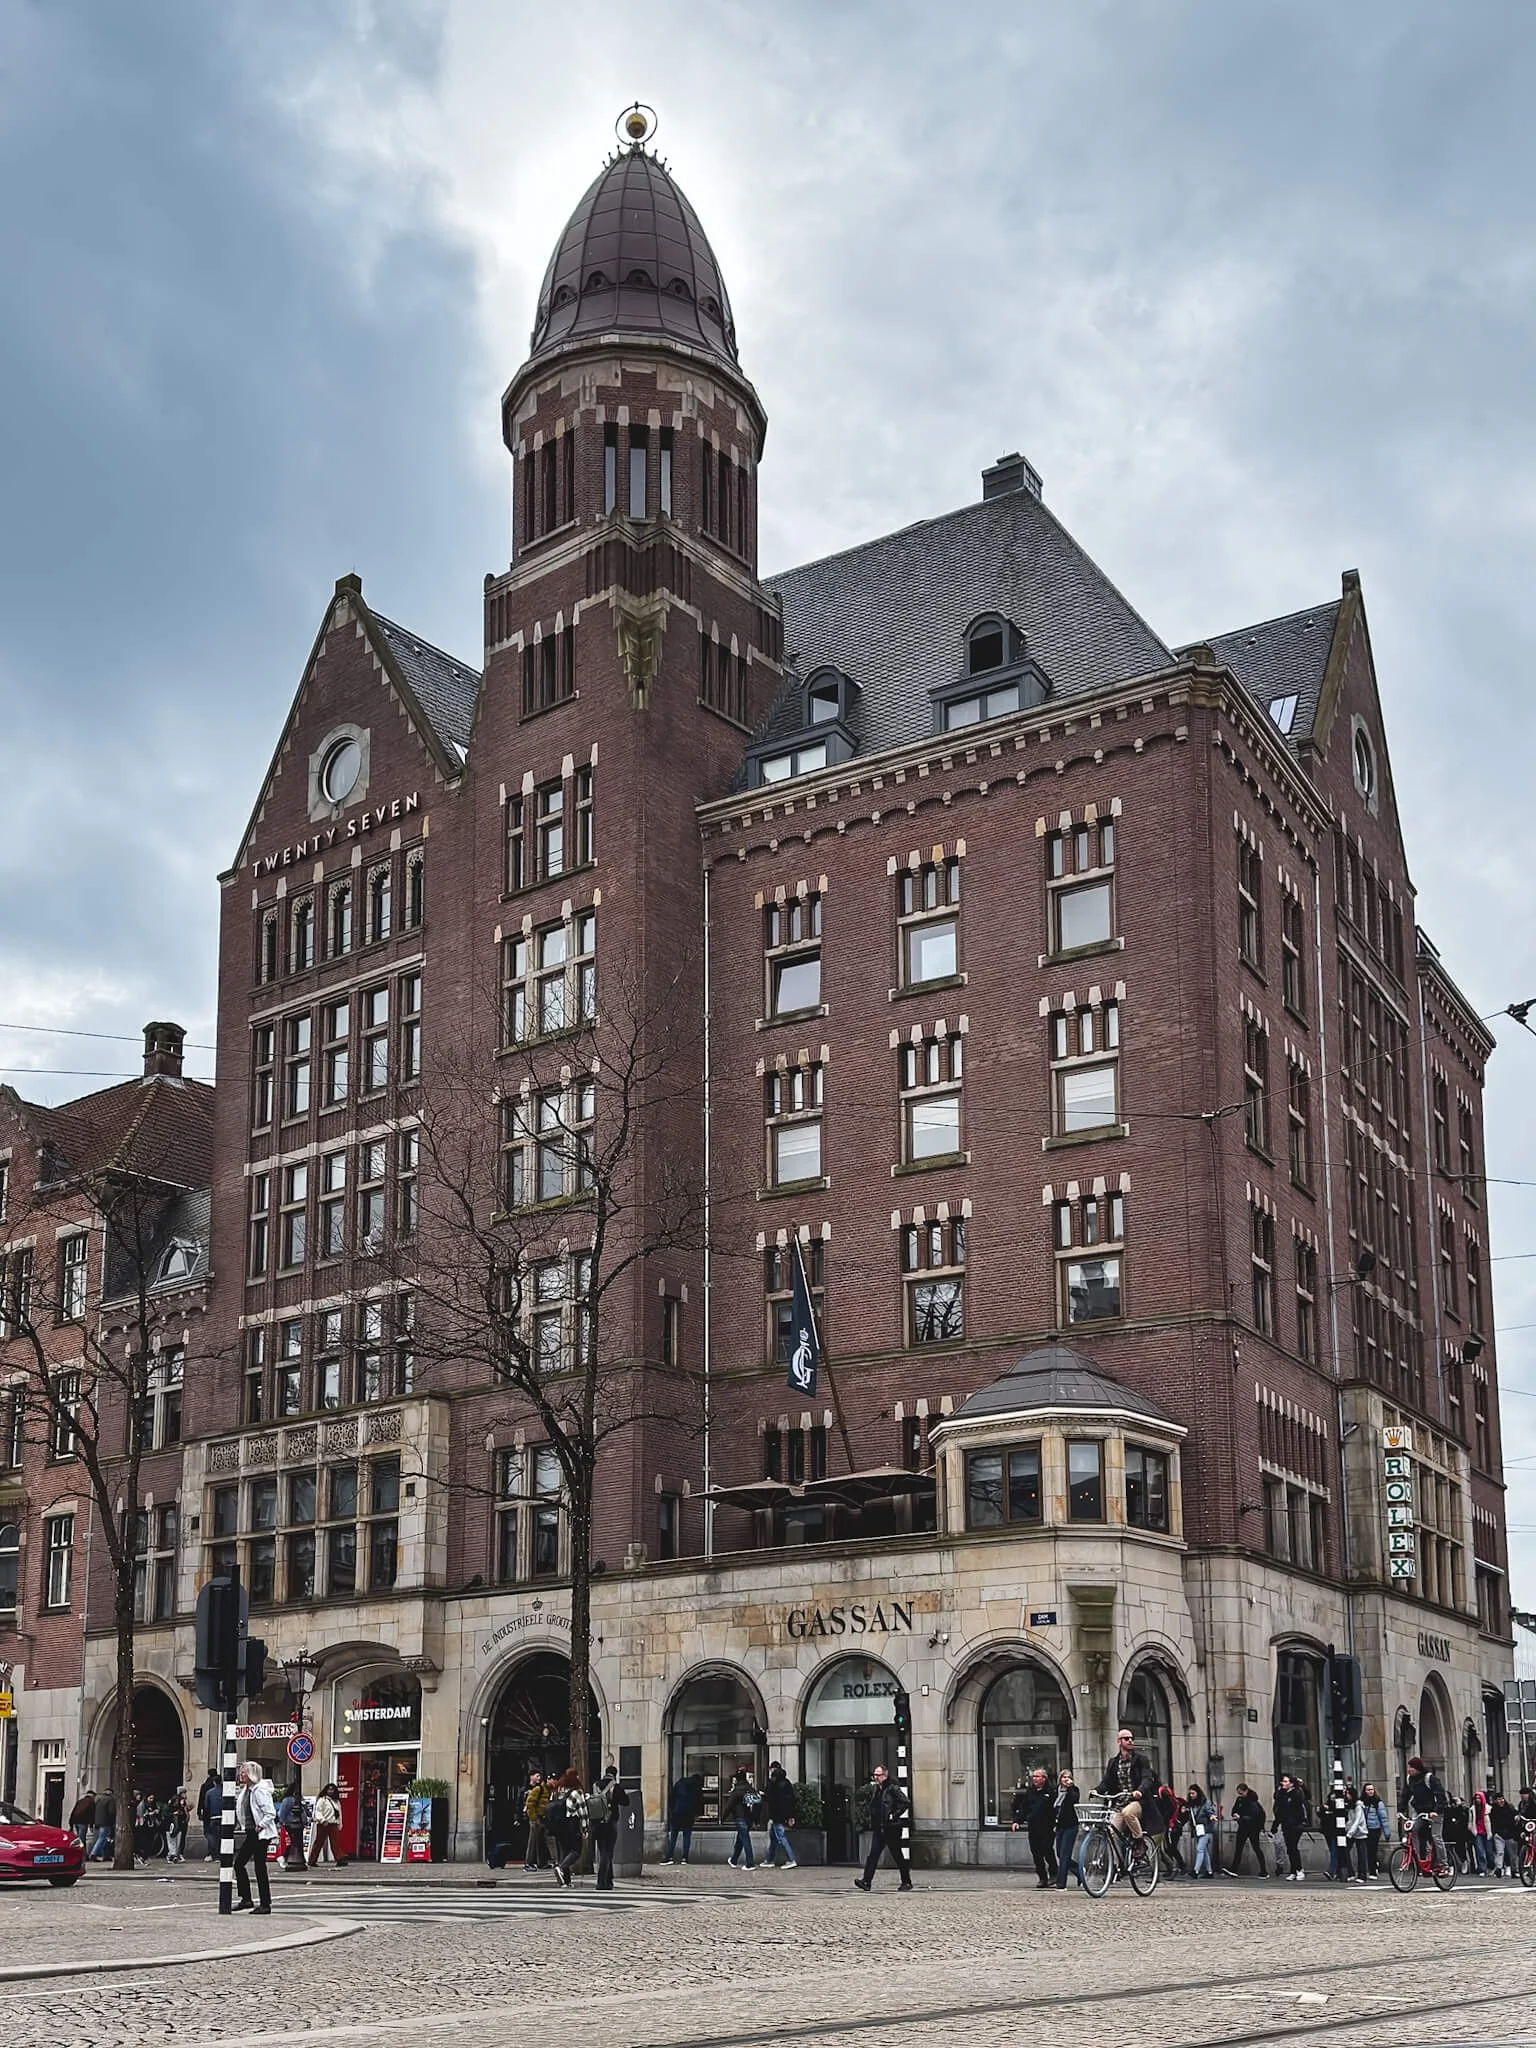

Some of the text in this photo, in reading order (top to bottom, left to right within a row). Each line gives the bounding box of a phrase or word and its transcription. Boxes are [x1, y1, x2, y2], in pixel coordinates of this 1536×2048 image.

[252, 791, 418, 878] TWENTY SEVEN
[1386, 1459, 1409, 1576] ROLEX
[481, 1642, 493, 1656] DE
[546, 1614, 573, 1631] GROOT
[787, 1600, 914, 1638] GASSAN
[1417, 1631, 1451, 1664] GASSAN
[843, 1682, 895, 1697] ROLEX
[235, 1723, 292, 1738] OURS & TICKETS
[347, 1706, 411, 1721] AMSTERDAM
